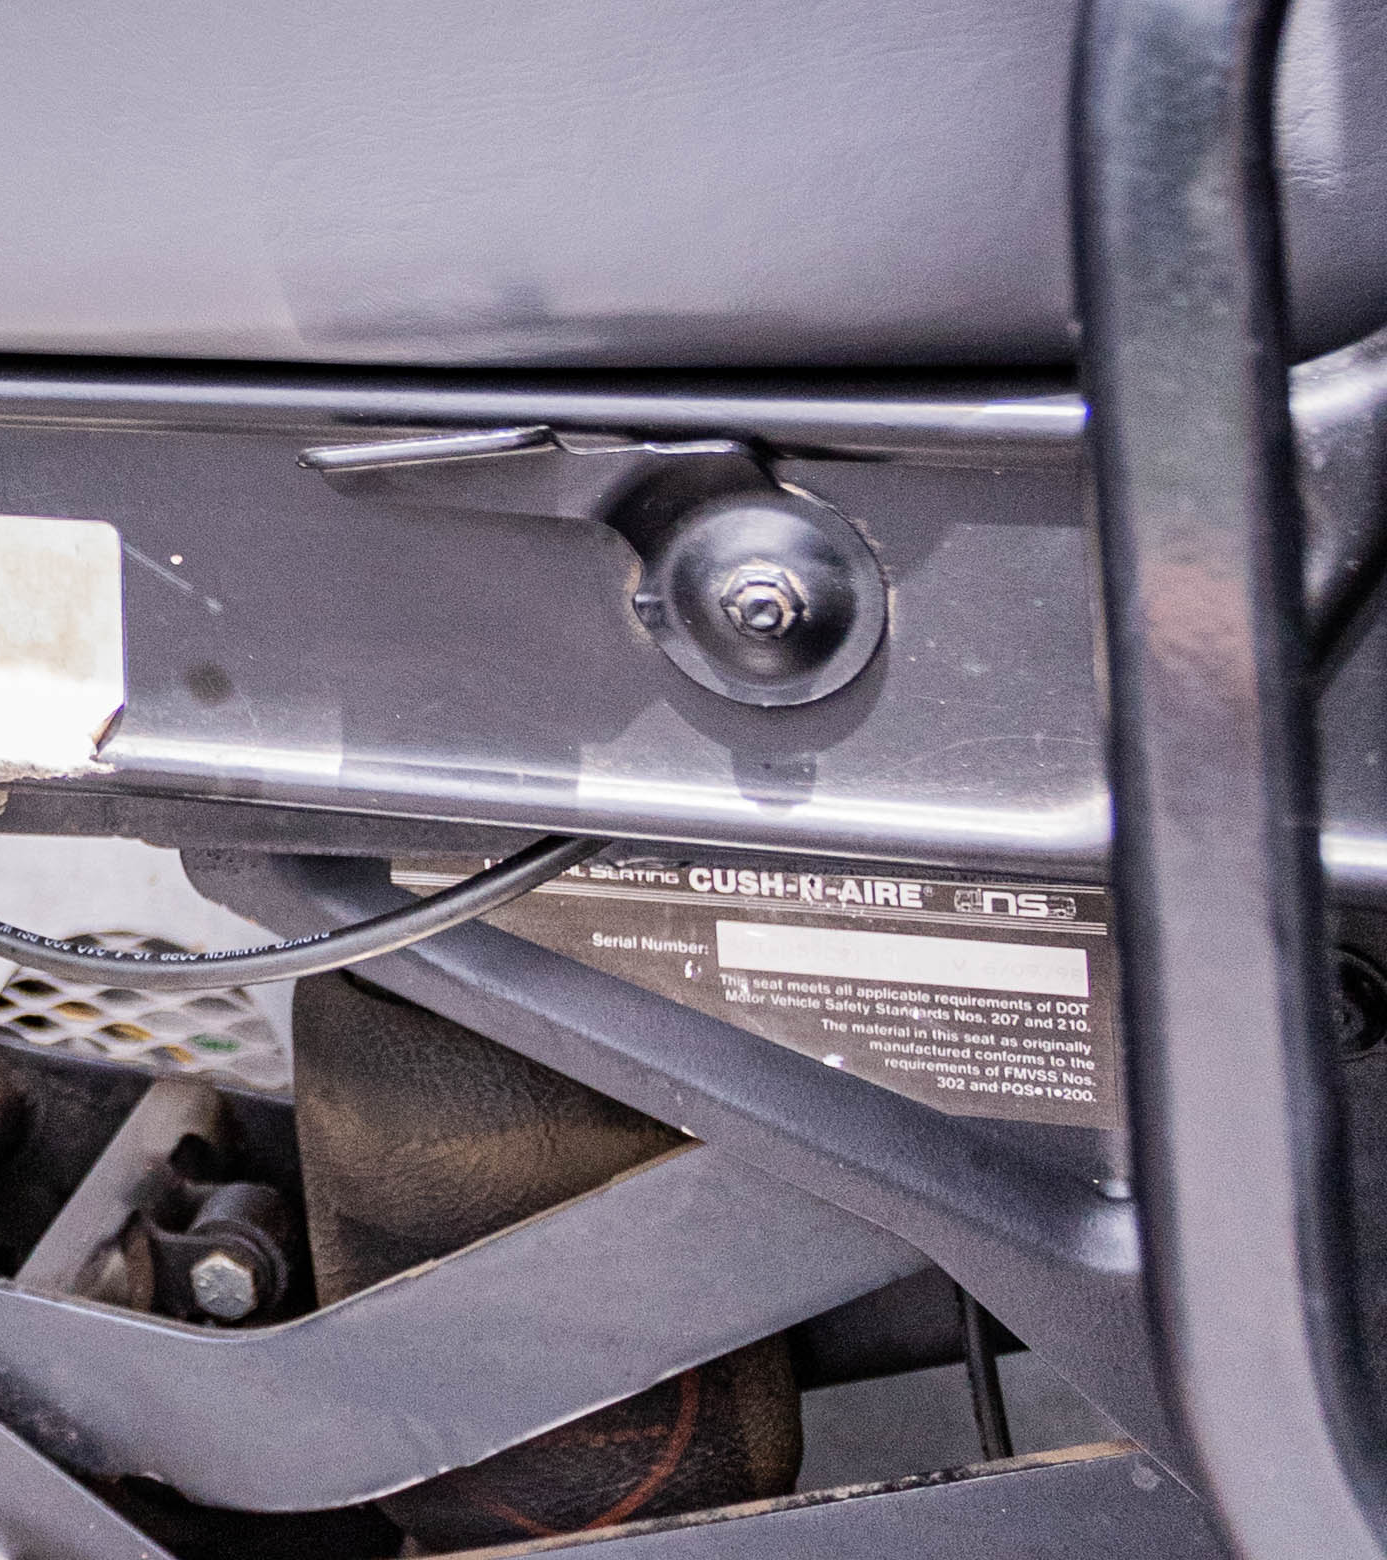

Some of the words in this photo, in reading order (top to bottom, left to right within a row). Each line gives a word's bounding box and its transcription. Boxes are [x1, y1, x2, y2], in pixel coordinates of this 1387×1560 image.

[592, 931, 638, 951] Serial
[641, 935, 710, 956] Number:
[719, 973, 750, 991] This
[753, 976, 784, 992] seat
[787, 980, 832, 996] meets
[835, 983, 853, 997] all
[856, 986, 931, 1003] applicable
[934, 993, 1033, 1012] requirements
[1036, 1000, 1052, 1013] of
[1056, 1001, 1090, 1016] DOT
[725, 989, 766, 1005] Motor
[770, 994, 821, 1010] Vehicle
[825, 998, 870, 1016] Safety
[875, 1003, 951, 1021] Standards
[954, 1009, 987, 1025] Nos.
[991, 1012, 1020, 1027] 207
[1024, 1017, 1054, 1030] and
[1057, 1018, 1092, 1033] 210.
[821, 1018, 848, 1033] The
[851, 1022, 911, 1039] material
[914, 1027, 928, 1040] in
[931, 1029, 959, 1043] this
[963, 1033, 996, 1047] seat
[1000, 1036, 1019, 1049] as
[1022, 1037, 1092, 1058] originally
[869, 1040, 972, 1060] manufactured
[975, 1049, 1045, 1067] conforms
[1050, 1055, 1067, 1068] to
[1070, 1056, 1096, 1071] the
[884, 1057, 981, 1078] requirements
[984, 1065, 1001, 1078] of
[1003, 1066, 1058, 1084] FMVSS
[1062, 1071, 1097, 1087] Nos.
[936, 1076, 965, 1091] 302
[969, 1079, 998, 1094] and
